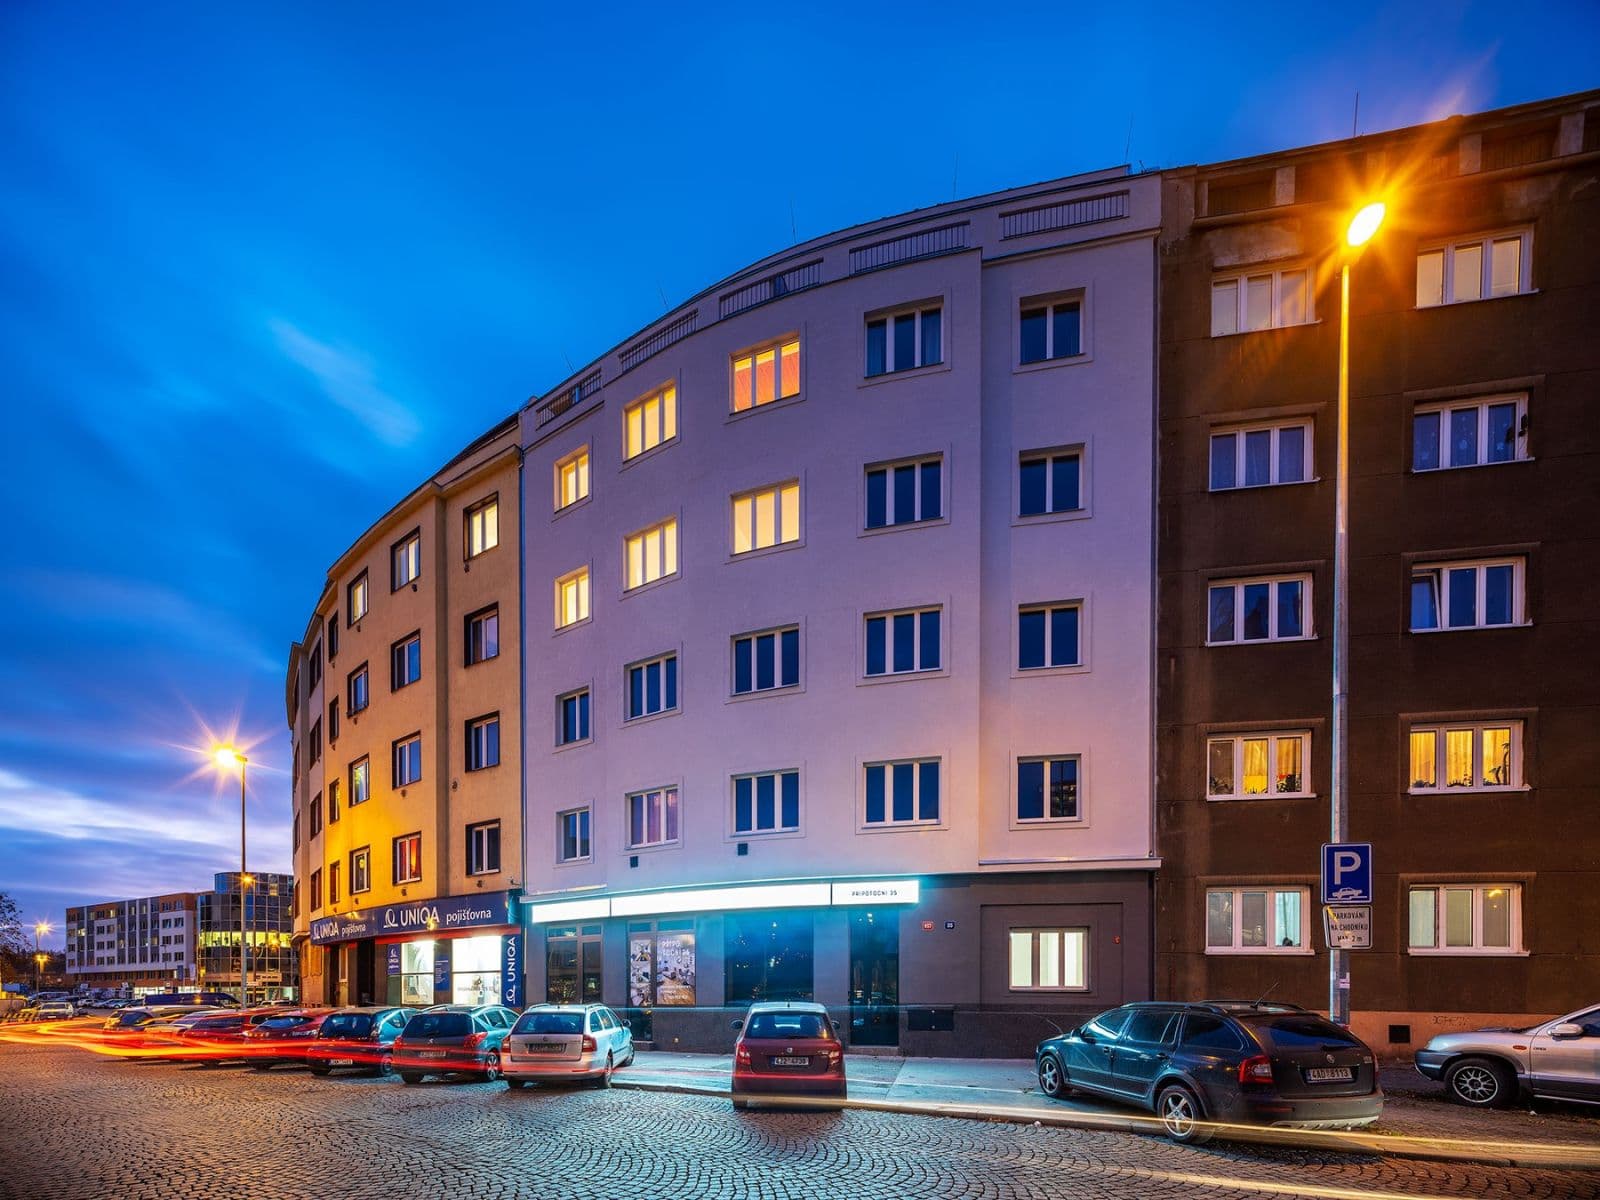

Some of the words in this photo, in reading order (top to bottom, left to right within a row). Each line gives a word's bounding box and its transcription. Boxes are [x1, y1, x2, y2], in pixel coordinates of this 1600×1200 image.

[1334, 851, 1361, 885] P
[319, 921, 339, 937] UNIQA
[400, 906, 440, 927] UNIQA
[446, 907, 492, 925] pojišťovna
[507, 936, 516, 982] UNIQA
